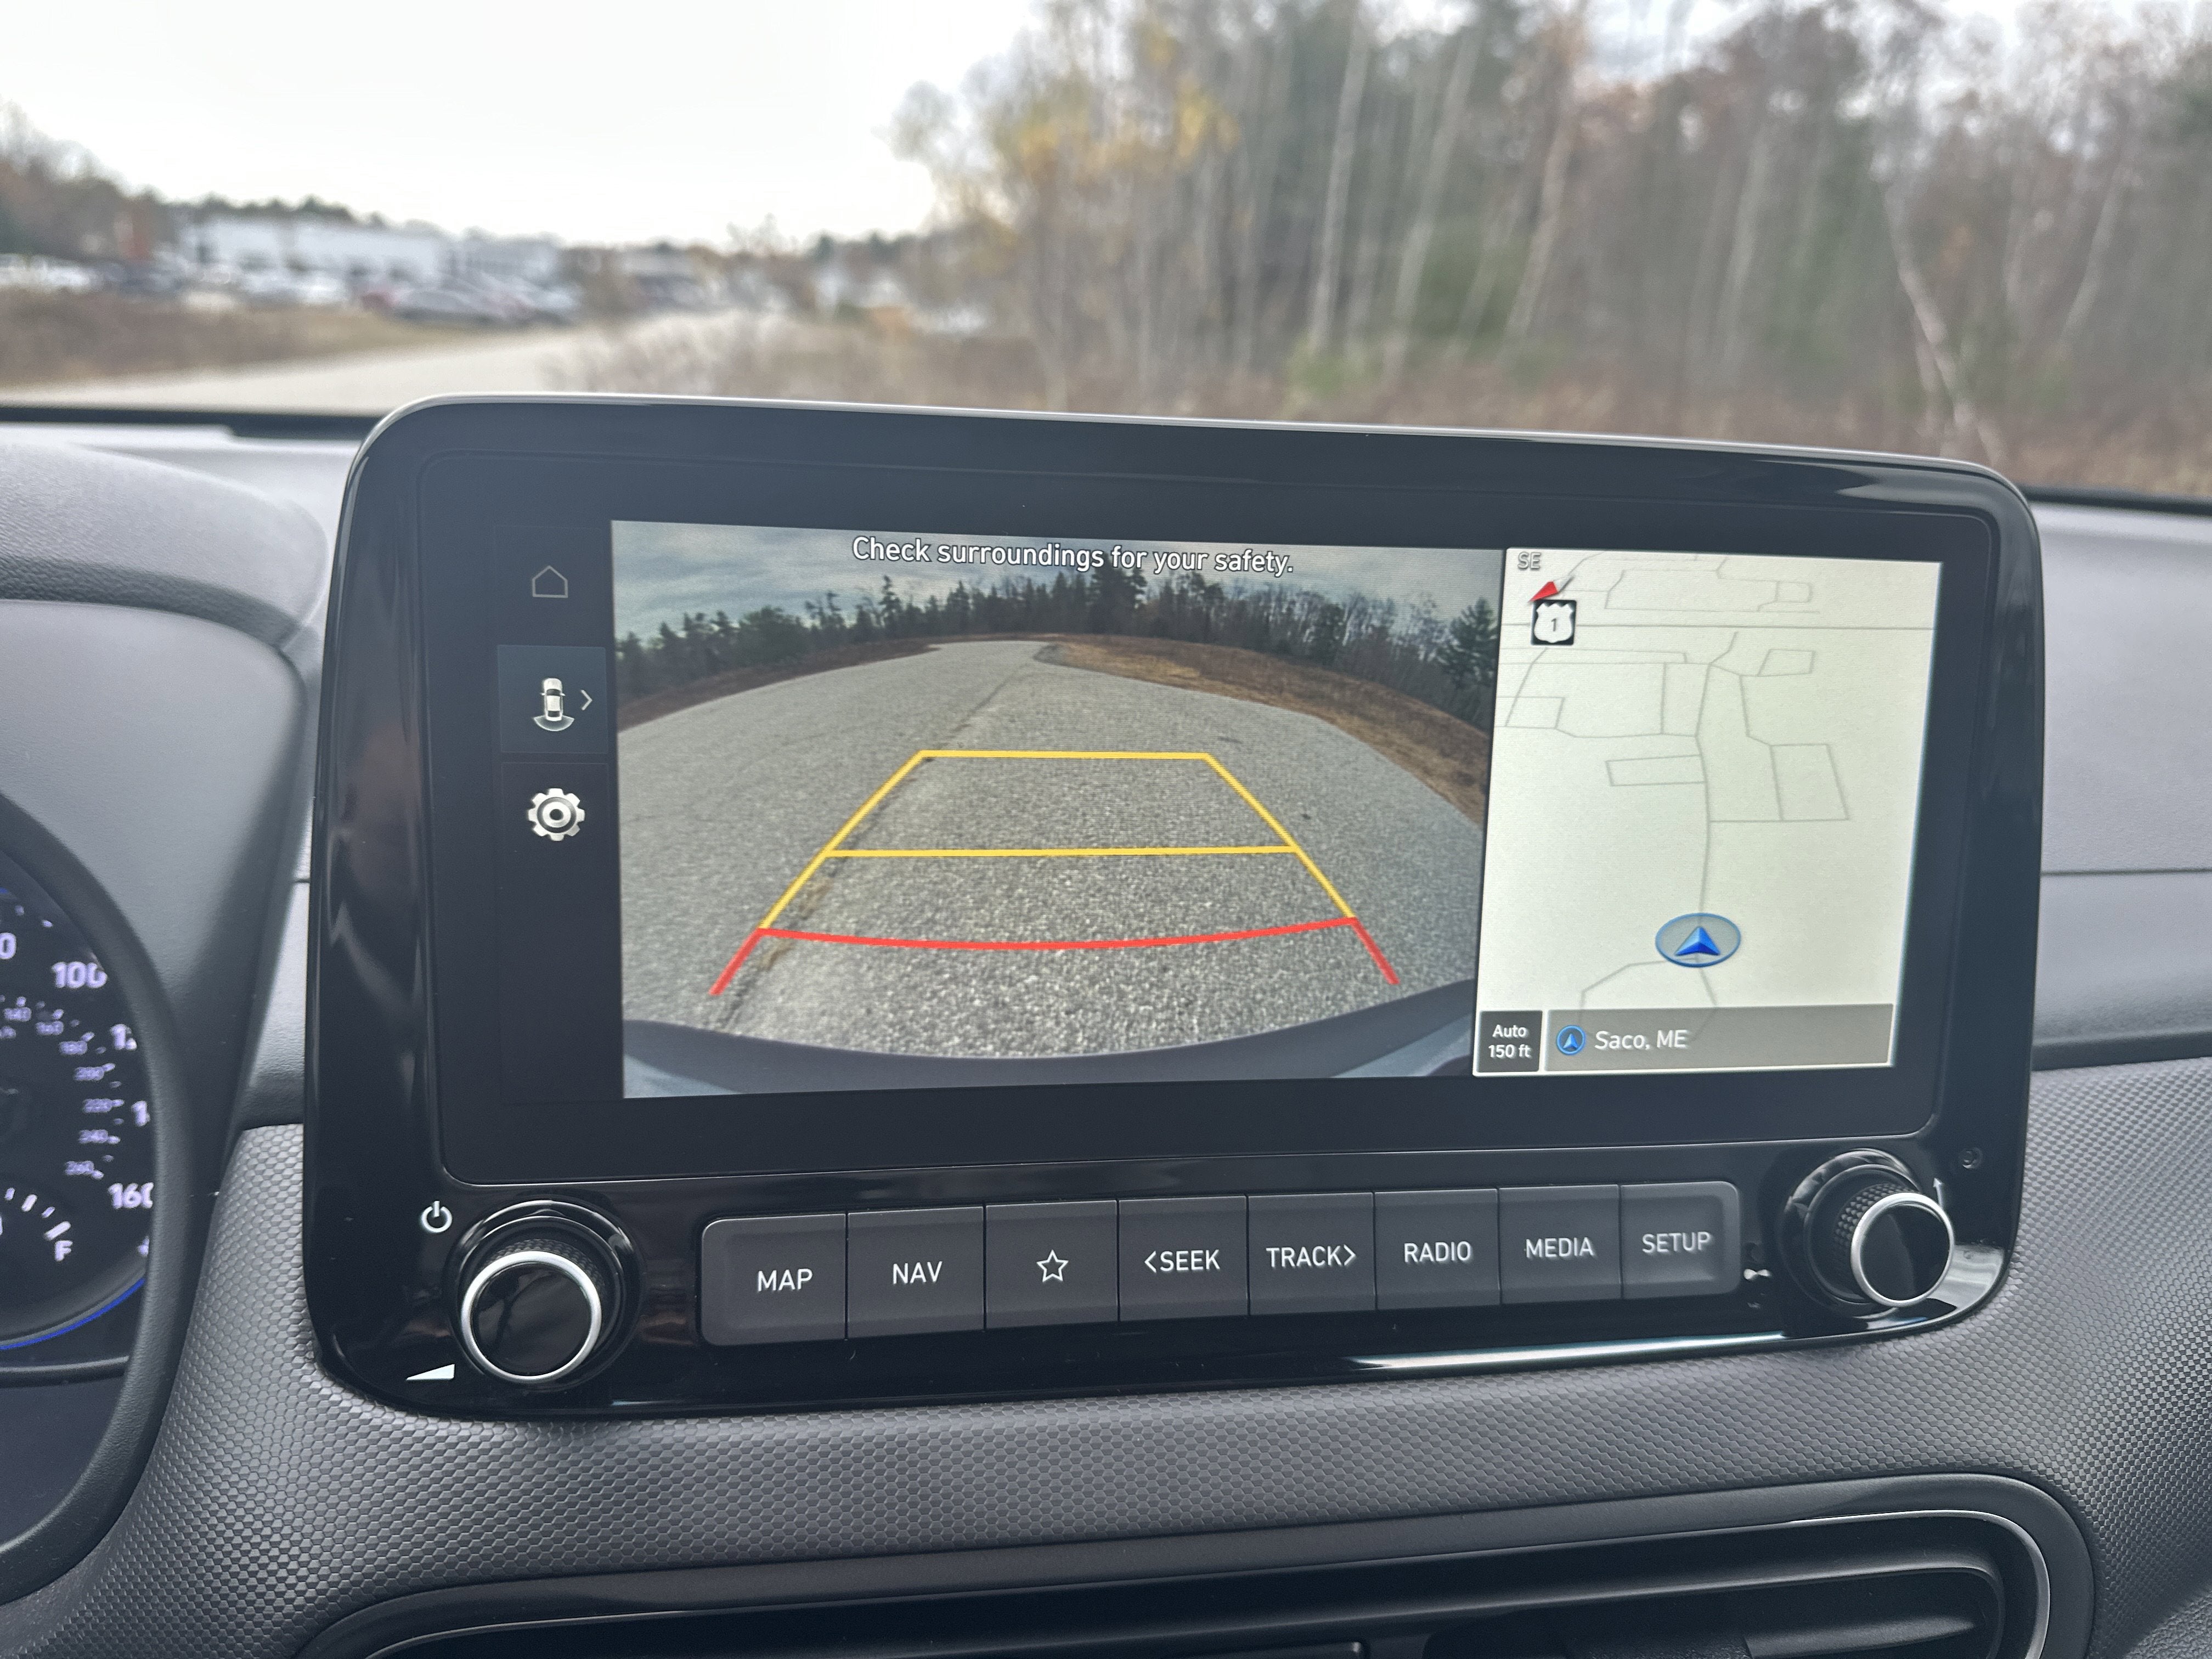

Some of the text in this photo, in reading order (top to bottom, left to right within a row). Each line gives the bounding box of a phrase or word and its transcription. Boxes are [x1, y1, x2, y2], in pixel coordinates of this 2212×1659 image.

[853, 537, 1293, 578] Check surroundings for your safety.
[1517, 552, 1541, 570] SE
[1551, 618, 1557, 631] 1
[1492, 1024, 1528, 1039] Auto
[1594, 1029, 1688, 1051] Saco, ME
[1488, 1043, 1532, 1059] 150 ft
[55, 1240, 73, 1261] F
[1404, 1241, 1472, 1263] RADIO
[1526, 1237, 1595, 1259] MEDIA
[1642, 1231, 1711, 1254] SETUP
[757, 1268, 813, 1292] MAP
[893, 1261, 943, 1284] NAV
